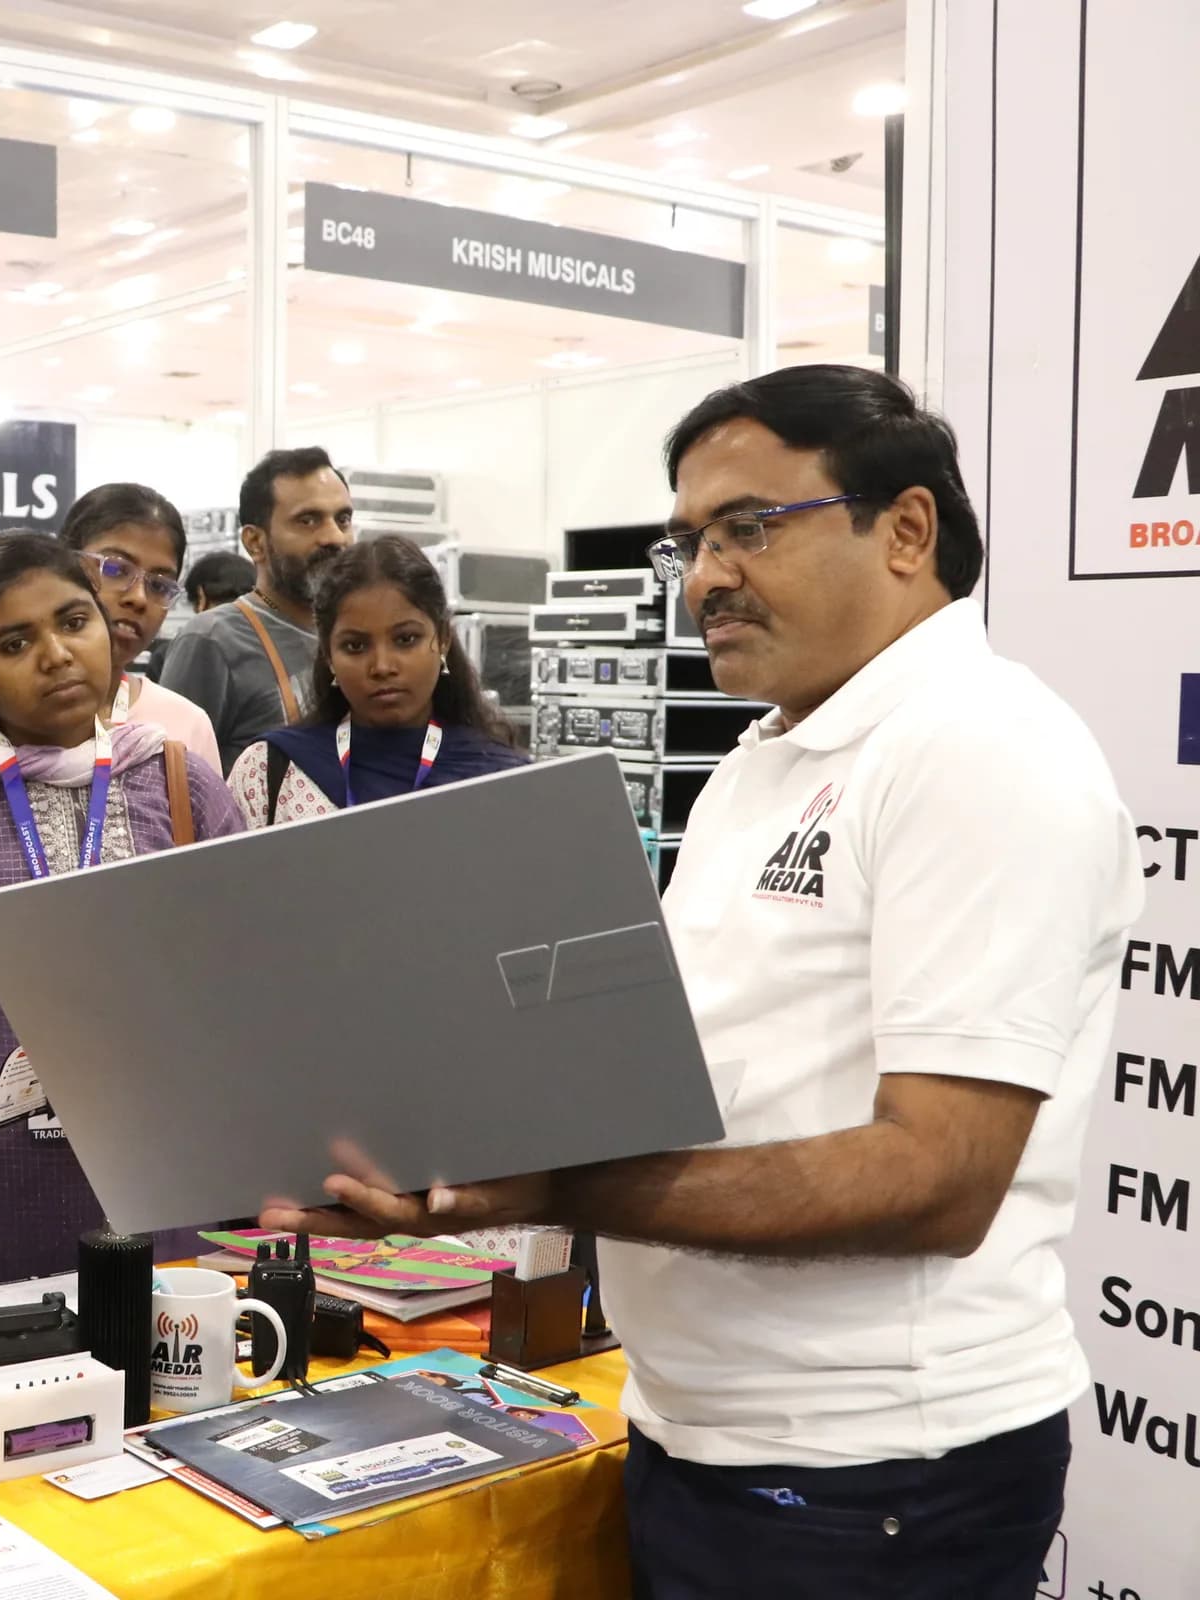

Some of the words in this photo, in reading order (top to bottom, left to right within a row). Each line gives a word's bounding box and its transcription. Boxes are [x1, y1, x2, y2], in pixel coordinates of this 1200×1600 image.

[322, 219, 375, 249] BC48
[452, 237, 521, 273] KRISH
[528, 250, 635, 295] MUSICALS
[1129, 519, 1200, 548] BRO
[20, 826, 42, 876] BROADCAST
[765, 814, 832, 871] AIR
[755, 868, 824, 898] MEDIA
[1114, 1051, 1197, 1117] FM
[1107, 1163, 1190, 1232] FM
[151, 1361, 203, 1376] MEDIA
[152, 1333, 203, 1364] AIR
[396, 1380, 465, 1411] BOOK
[458, 1407, 549, 1449] VISITOR
